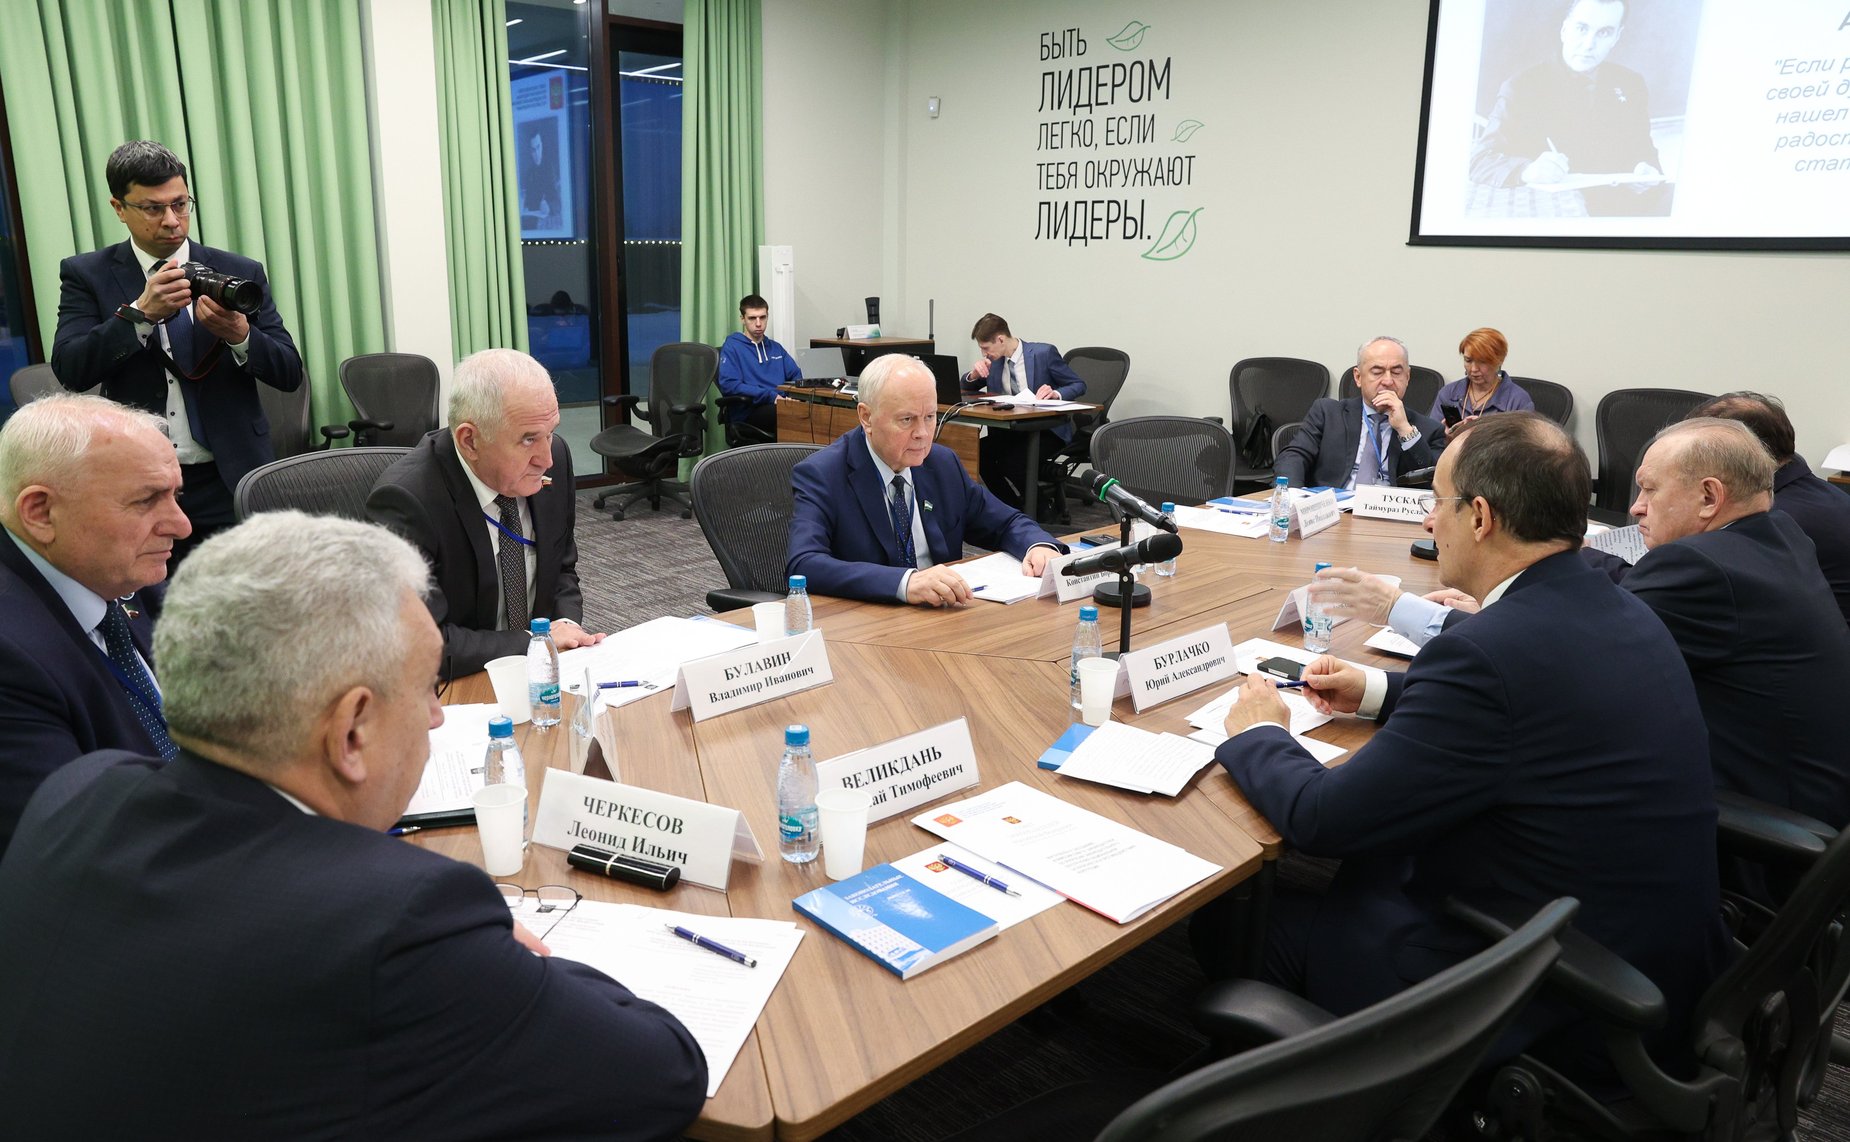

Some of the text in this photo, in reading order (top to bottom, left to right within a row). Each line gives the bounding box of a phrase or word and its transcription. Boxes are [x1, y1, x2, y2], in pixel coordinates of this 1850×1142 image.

[1040, 27, 1087, 61] БЫТЬ
[1775, 58, 1836, 75] "Если
[1038, 57, 1172, 116] ЛИДЕРОМ
[1766, 79, 1850, 101] своей д
[1037, 113, 1155, 151] ЛЕГКО, ЕСЛИ
[1776, 107, 1849, 125] нашел
[1036, 155, 1196, 190] ТЕБЯ ОКРУЖАЮТ
[1034, 199, 1152, 247] ЛИДЕРЫ.
[723, 651, 792, 681] БУЛАВИН
[1153, 640, 1210, 670] БУРЛАЧКО
[709, 666, 814, 703] Владимир Иванович
[1145, 656, 1226, 691] Юрий Александрович
[841, 746, 942, 790] ВЕЛИКДАНЬ
[889, 764, 964, 798] Тимофеевич
[583, 796, 684, 835] ЧЕРКЕСОВ
[567, 820, 688, 865] Леонид Ильич
